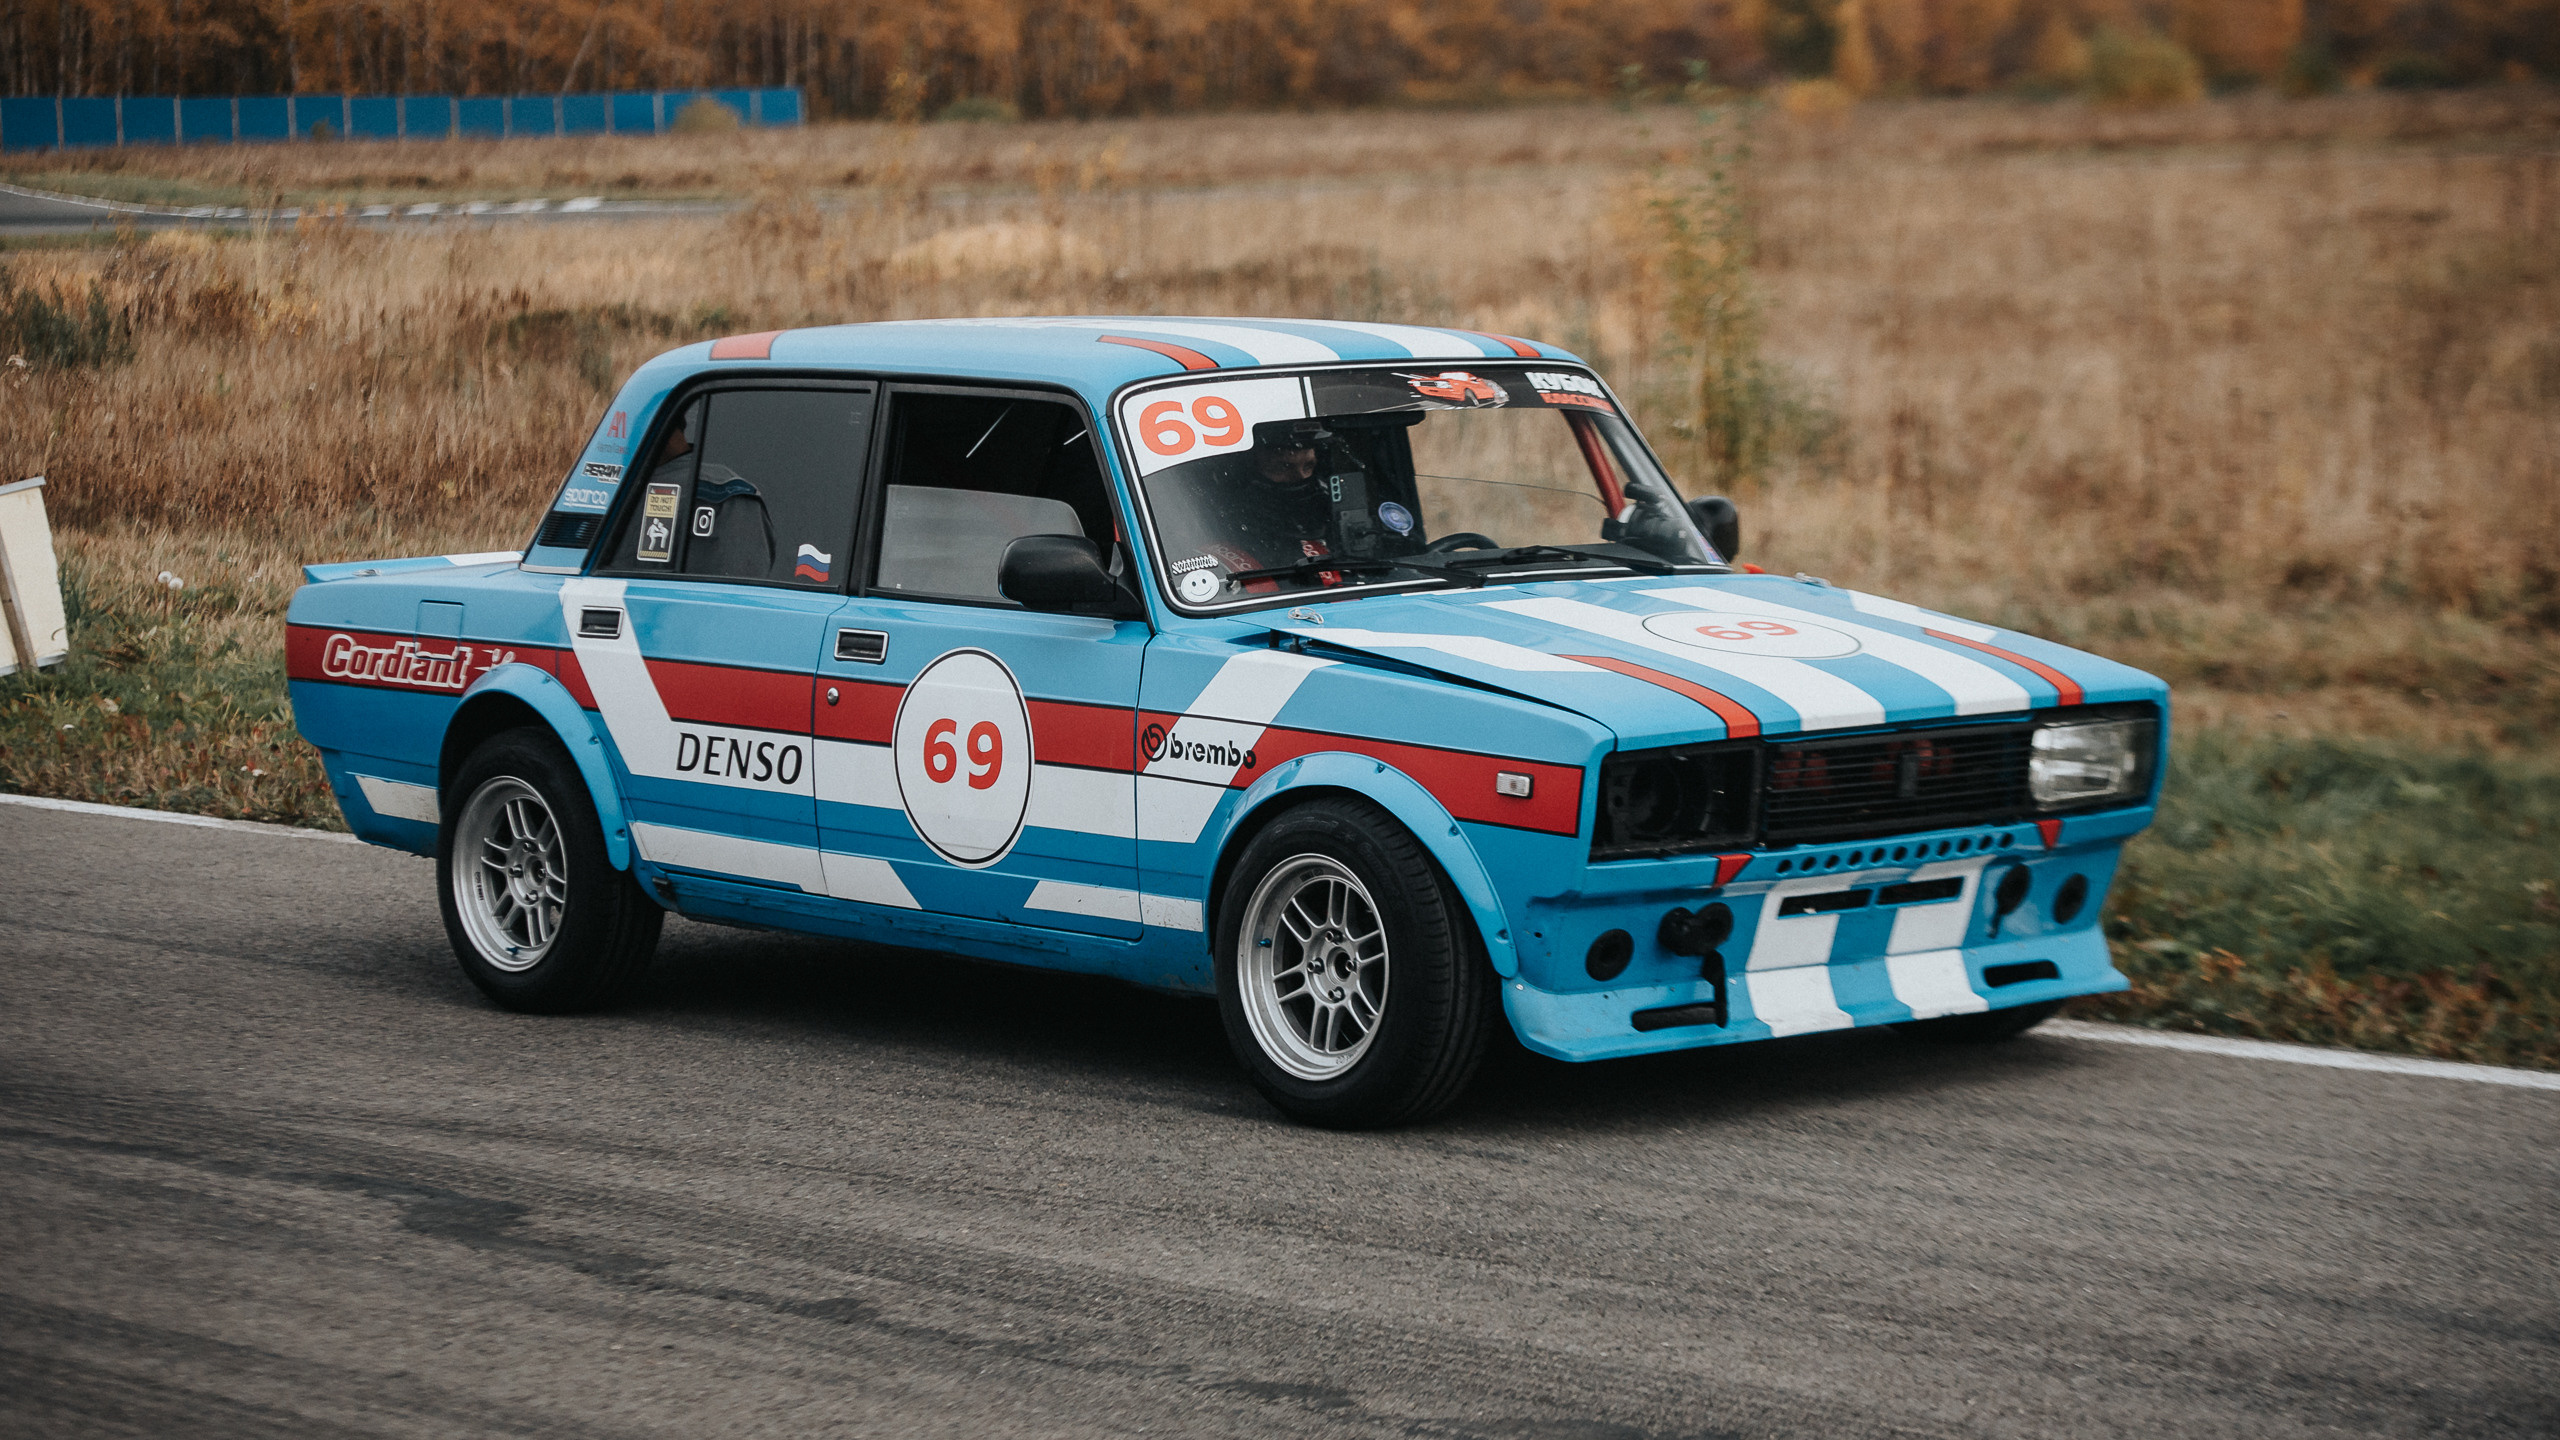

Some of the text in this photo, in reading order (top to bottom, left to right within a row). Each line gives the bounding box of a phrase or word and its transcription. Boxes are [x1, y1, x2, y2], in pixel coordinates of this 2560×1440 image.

[1139, 396, 1244, 456] 69
[564, 488, 609, 506] sparco
[1696, 621, 1798, 640] 69
[322, 634, 473, 688] Cordiant
[676, 732, 802, 785] DENSO
[923, 718, 1003, 790] 69
[1170, 733, 1257, 769] brembo
